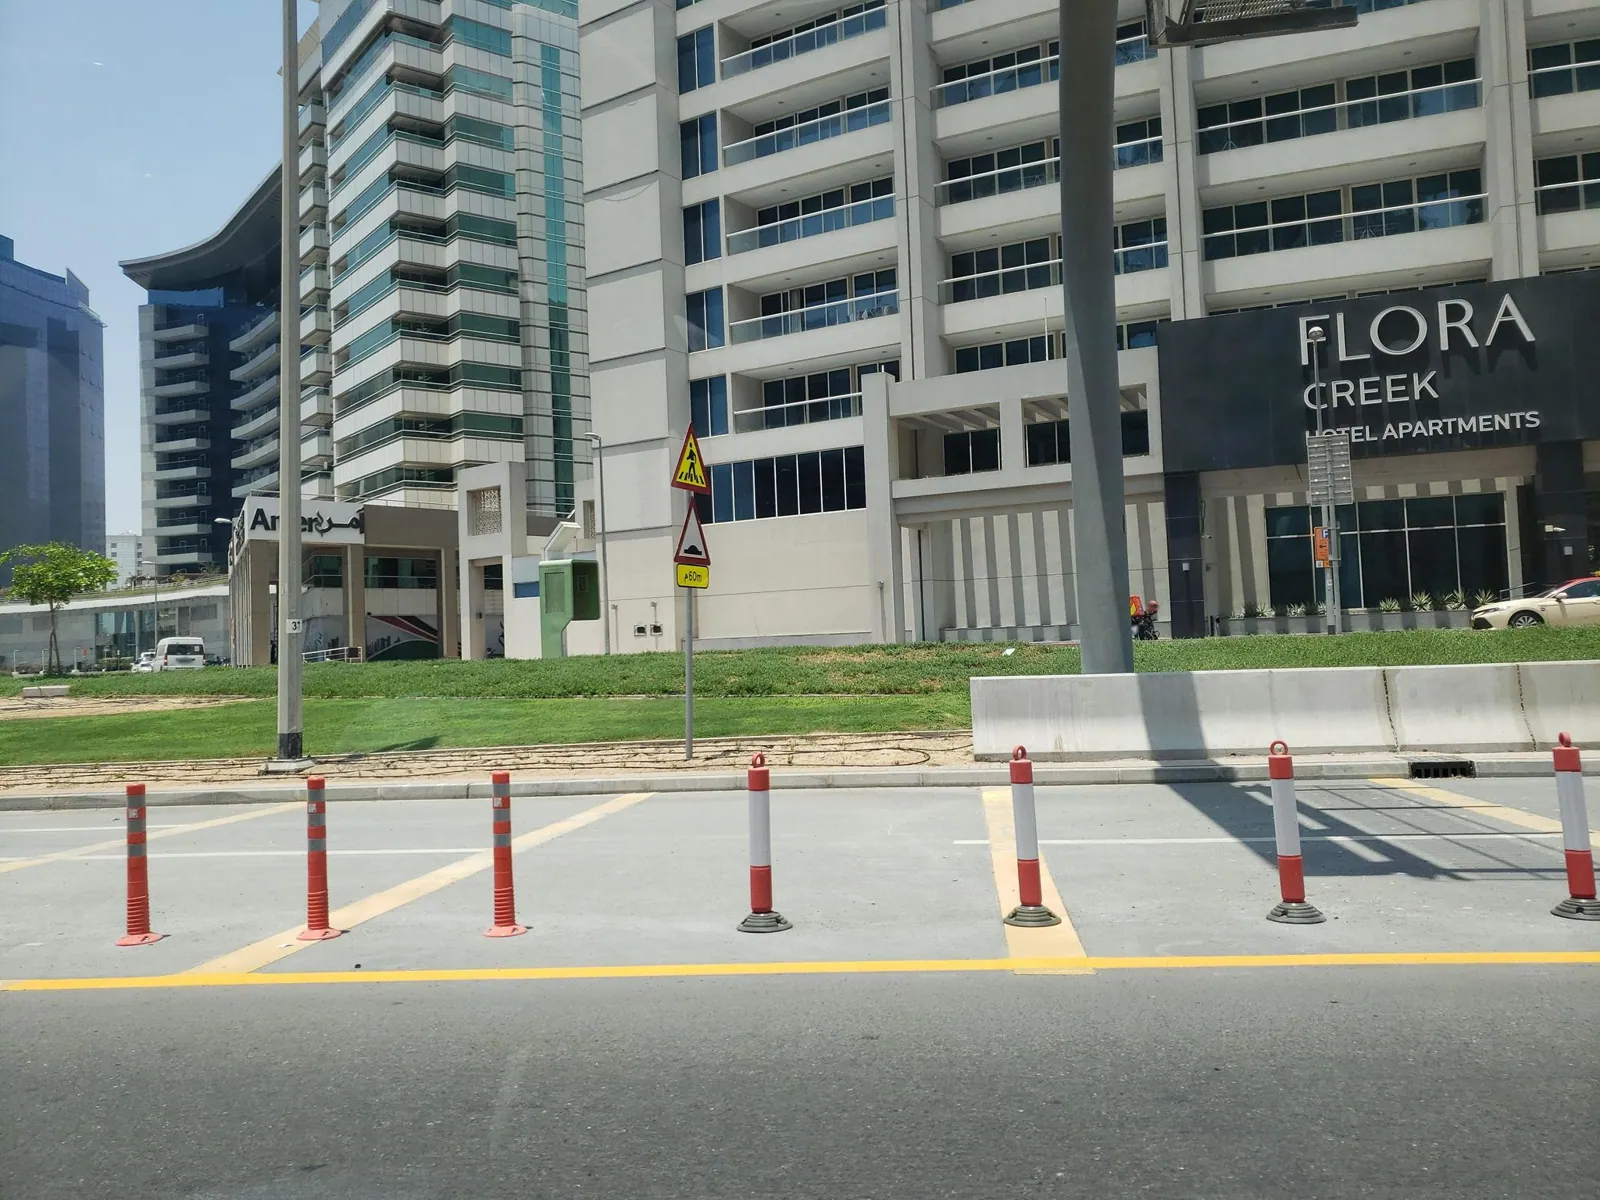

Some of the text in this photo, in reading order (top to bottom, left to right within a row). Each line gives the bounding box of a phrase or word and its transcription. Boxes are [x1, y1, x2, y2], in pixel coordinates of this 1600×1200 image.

[1299, 293, 1536, 365] FLORA
[1303, 370, 1439, 410] CREEK
[1382, 411, 1541, 440] APARTMENTS
